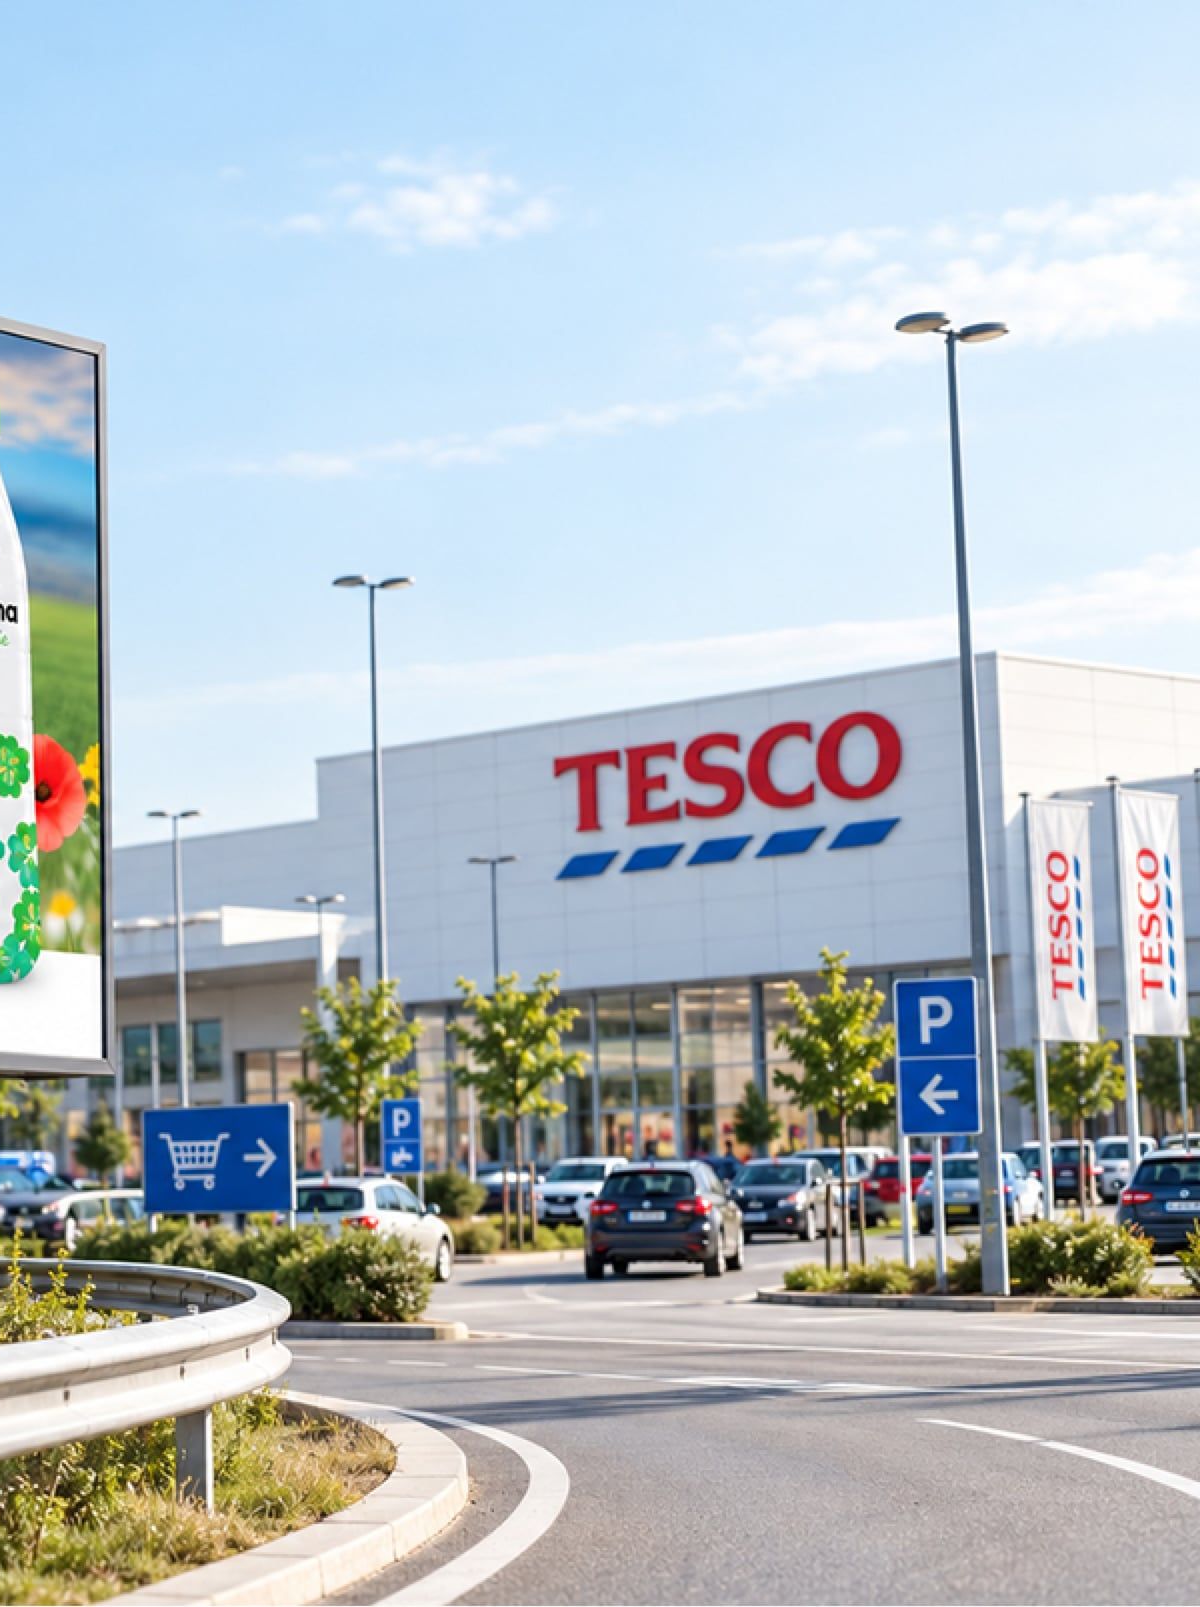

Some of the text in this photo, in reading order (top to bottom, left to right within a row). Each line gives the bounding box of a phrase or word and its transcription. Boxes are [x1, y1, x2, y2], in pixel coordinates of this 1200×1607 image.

[554, 711, 901, 832] TESCO
[1046, 850, 1074, 999] TESCO
[1136, 847, 1165, 999] TESCO
[919, 995, 953, 1044] P
[392, 1107, 411, 1137] P
